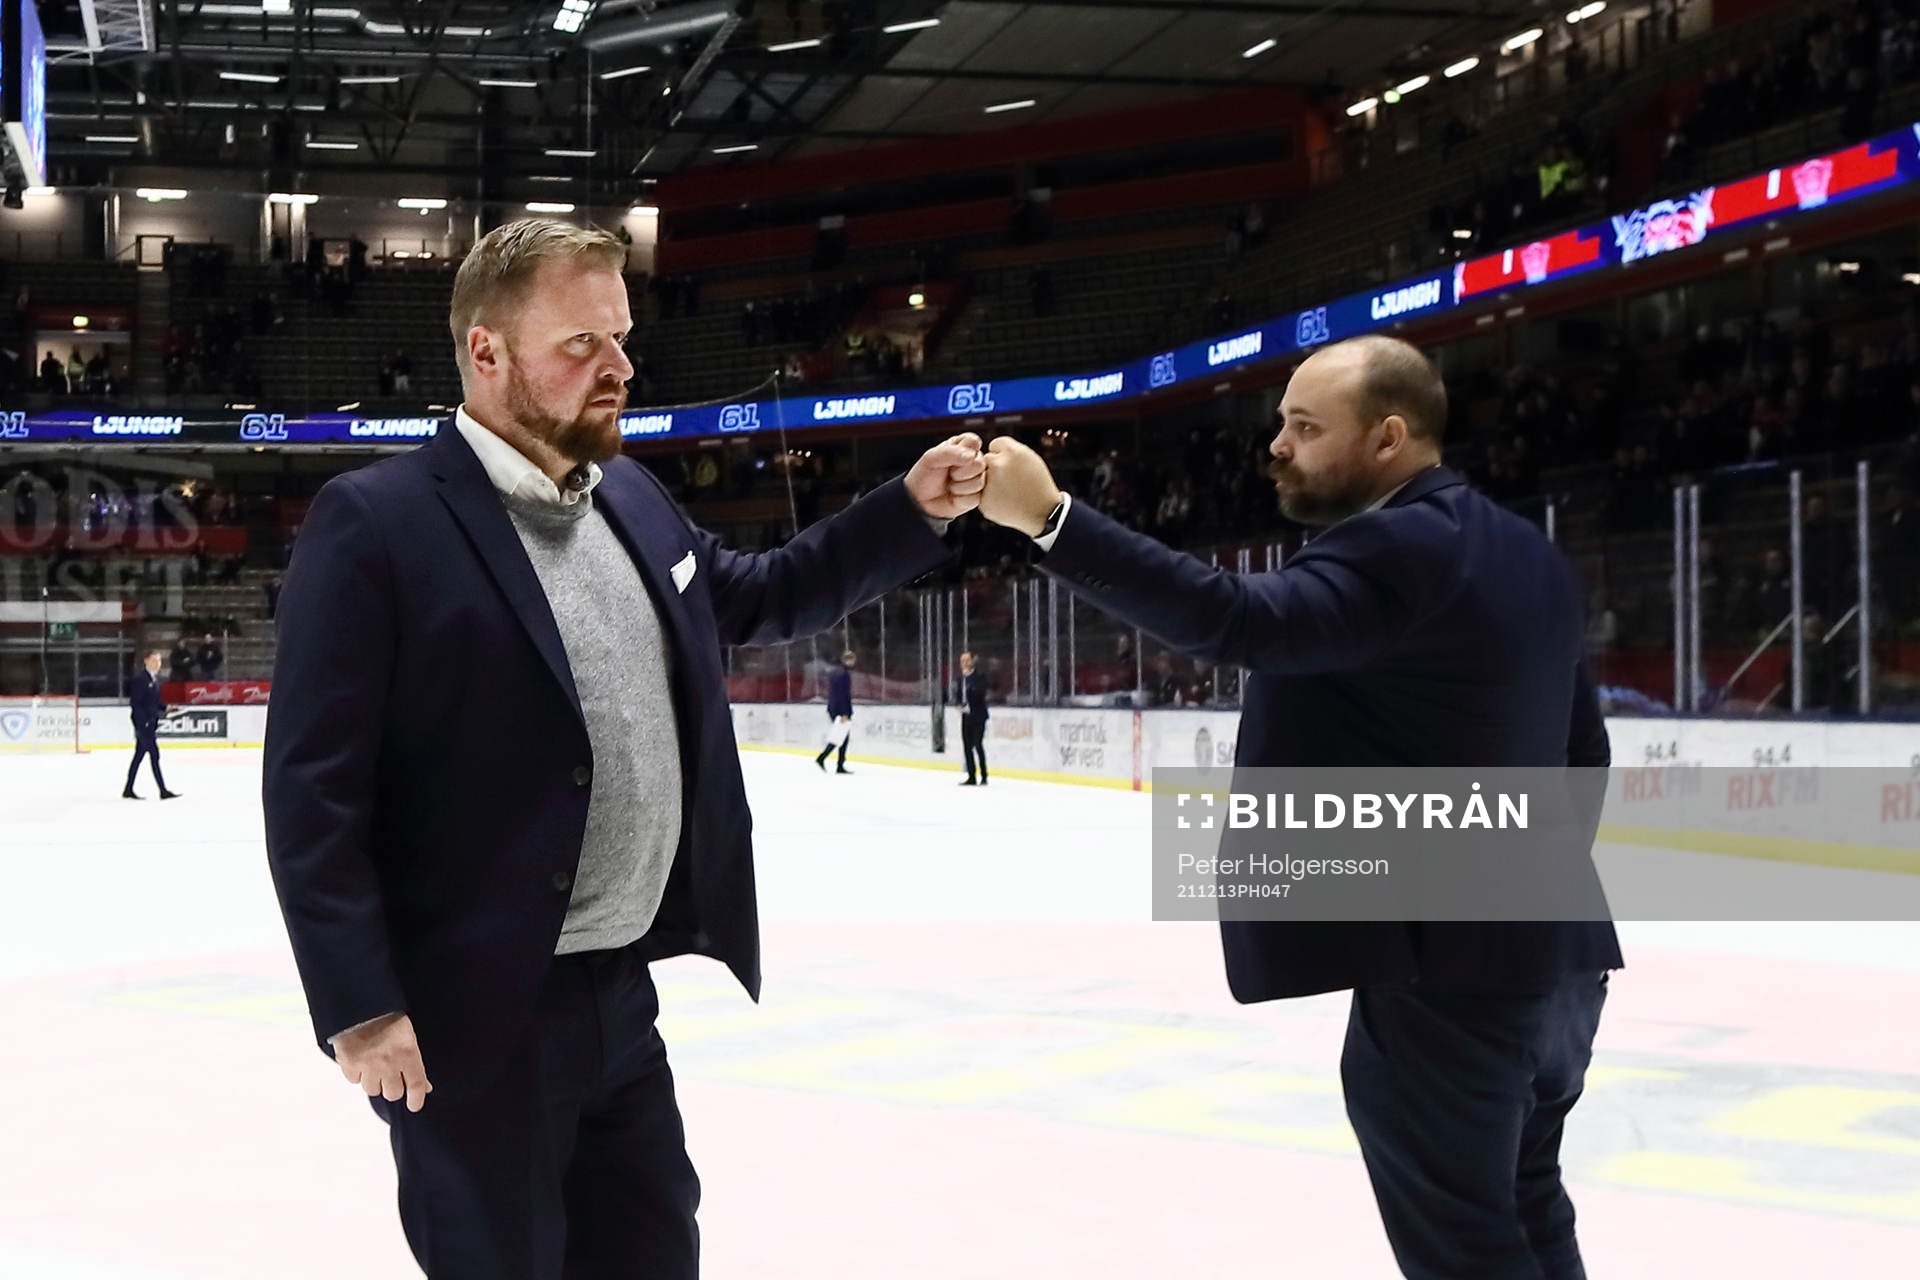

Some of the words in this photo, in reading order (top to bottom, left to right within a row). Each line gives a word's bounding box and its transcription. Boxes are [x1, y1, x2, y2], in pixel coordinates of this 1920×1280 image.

[1370, 278, 1442, 321] LJUNGH
[1296, 306, 1330, 347] 61
[1207, 331, 1263, 366] LJUNGH
[1150, 352, 1177, 388] 61
[947, 382, 996, 415] 61
[1055, 371, 1124, 402] LJUNGH
[718, 402, 761, 432] 61
[813, 395, 896, 420] LJUNGH
[92, 415, 183, 435] LJUNGH
[239, 413, 290, 440] 61
[349, 418, 439, 437] LJUNGH
[618, 414, 674, 436] UNGH
[156, 715, 219, 734] adium
[1753, 744, 1792, 769] 94.4
